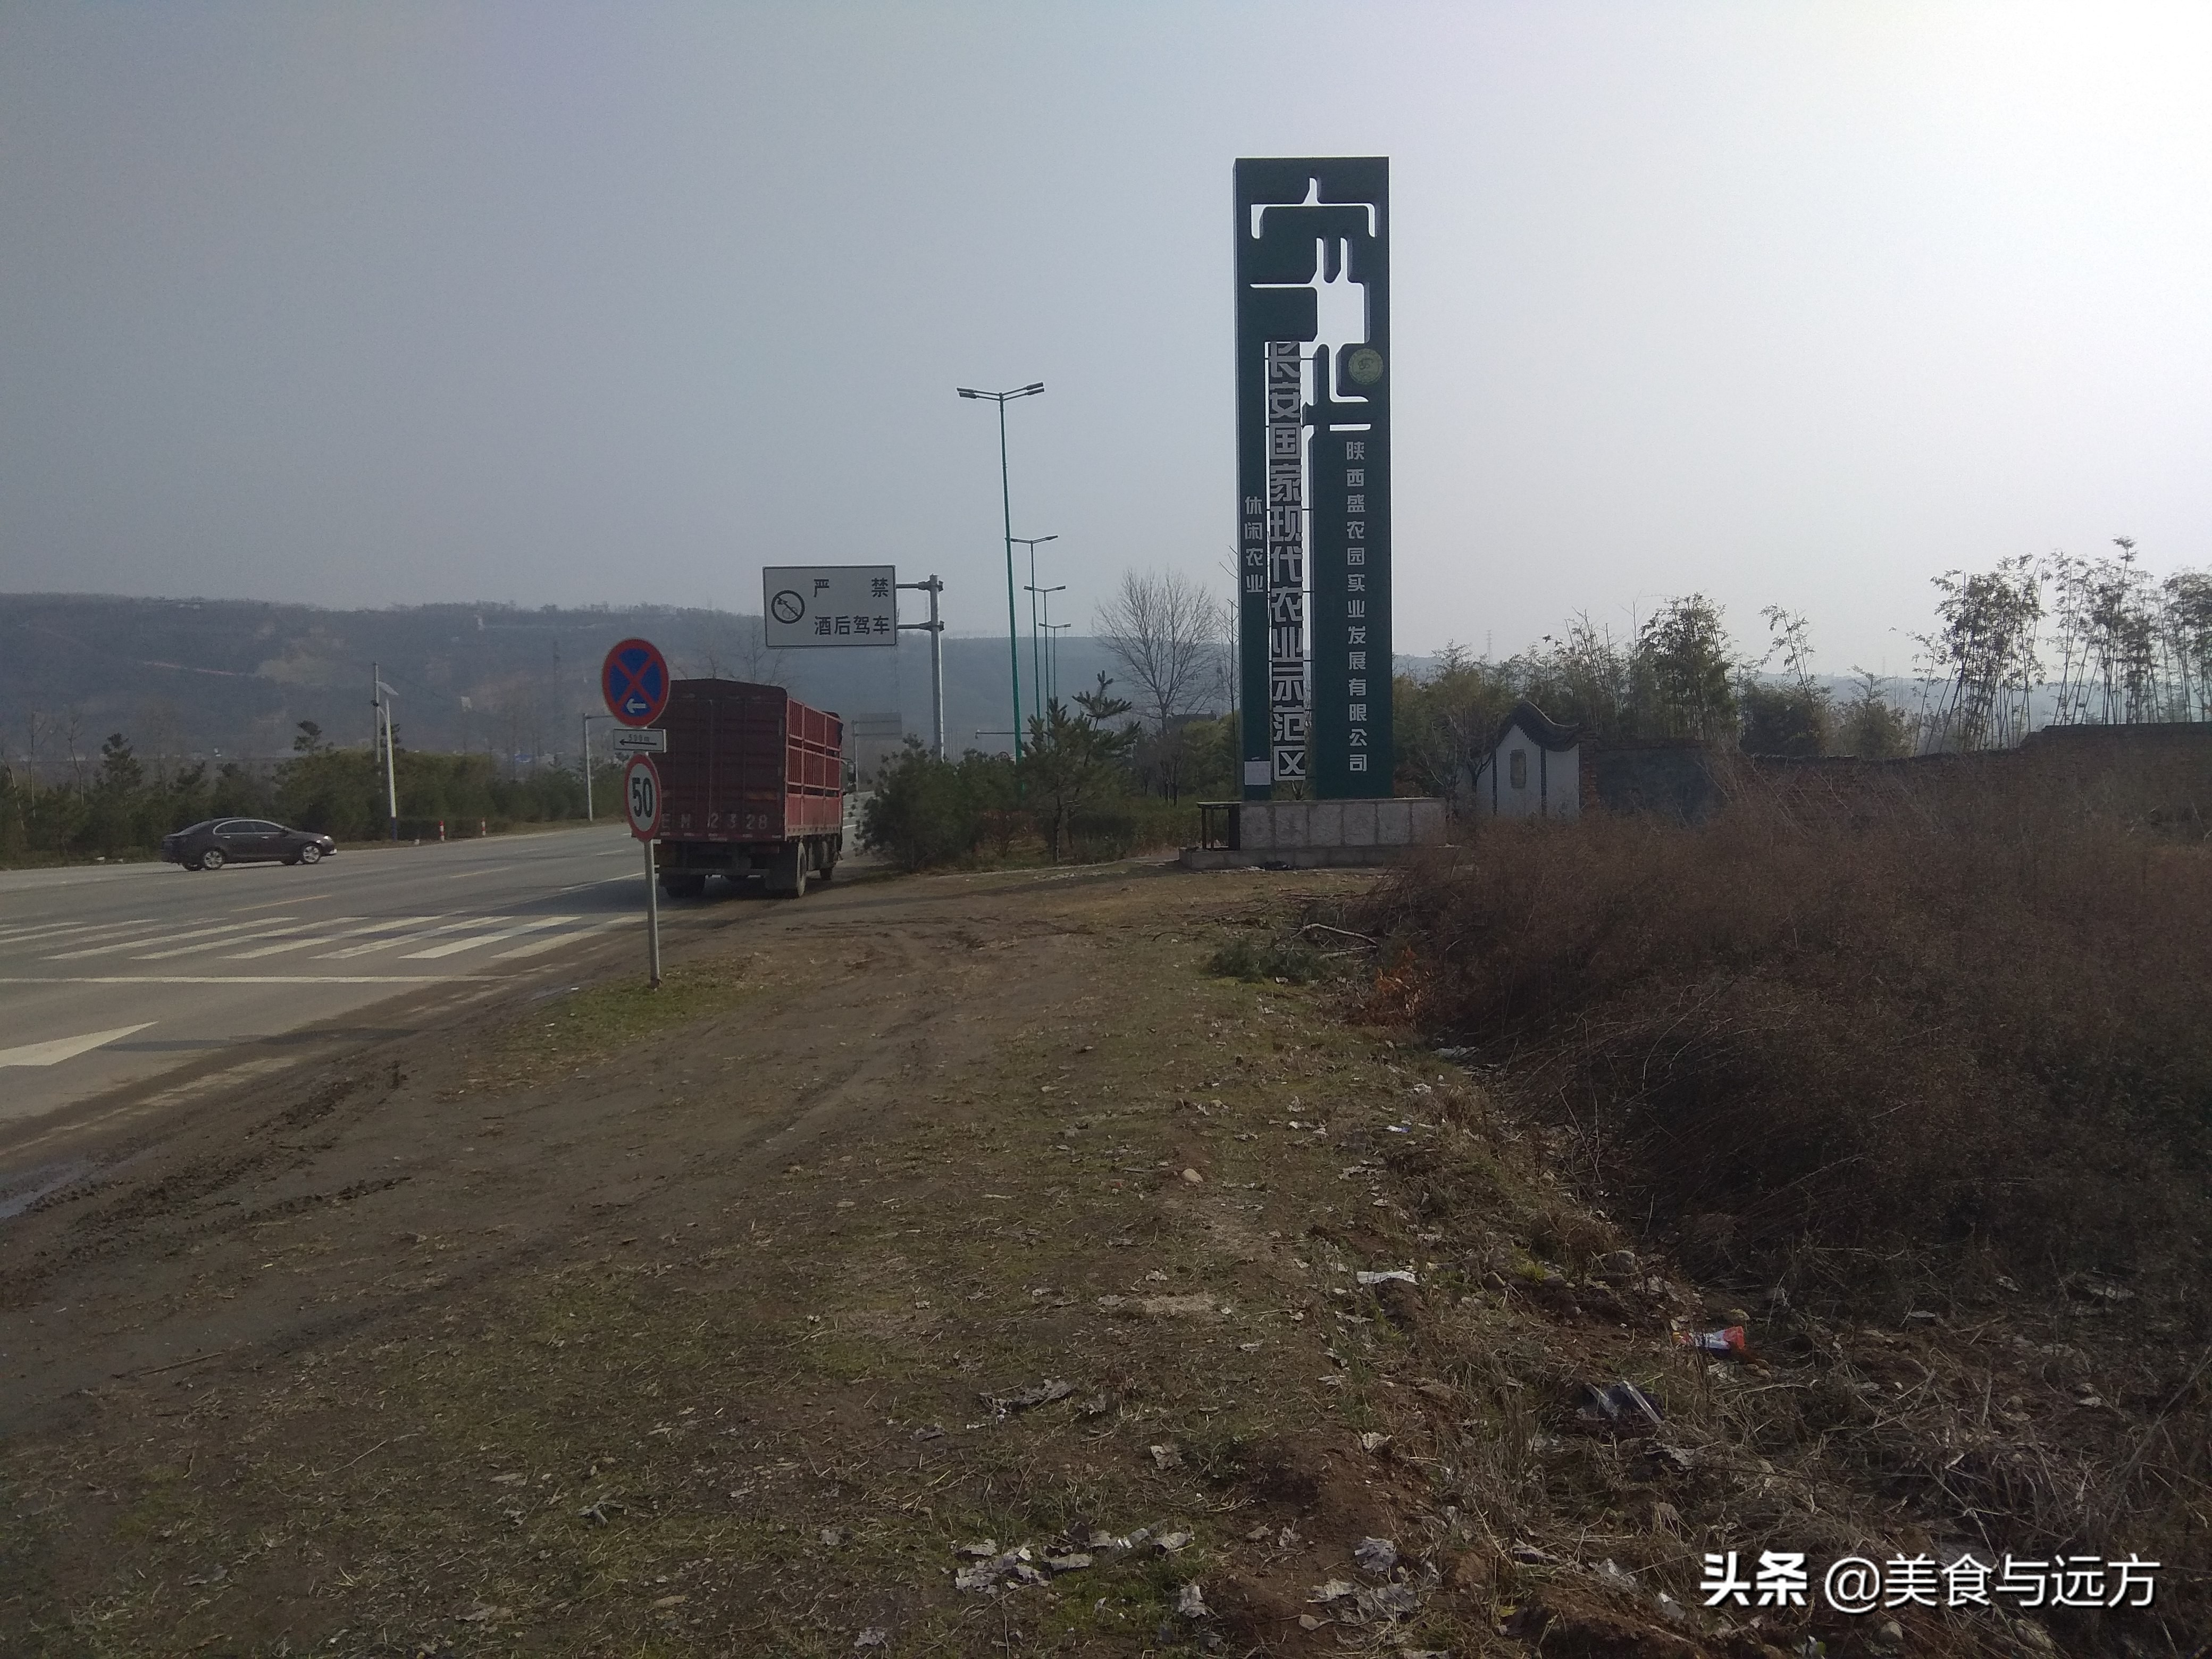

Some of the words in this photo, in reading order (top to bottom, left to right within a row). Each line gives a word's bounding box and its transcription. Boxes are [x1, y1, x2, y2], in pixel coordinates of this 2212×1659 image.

[1244, 496, 1263, 593] 休闲农业
[1269, 340, 1306, 781] 长安国家现代农业示范区
[814, 578, 889, 598] 严禁
[1346, 441, 1368, 772] 陕西盛农园实业发展有限公司
[814, 616, 890, 635] 酒后驾车
[632, 777, 653, 817] 50
